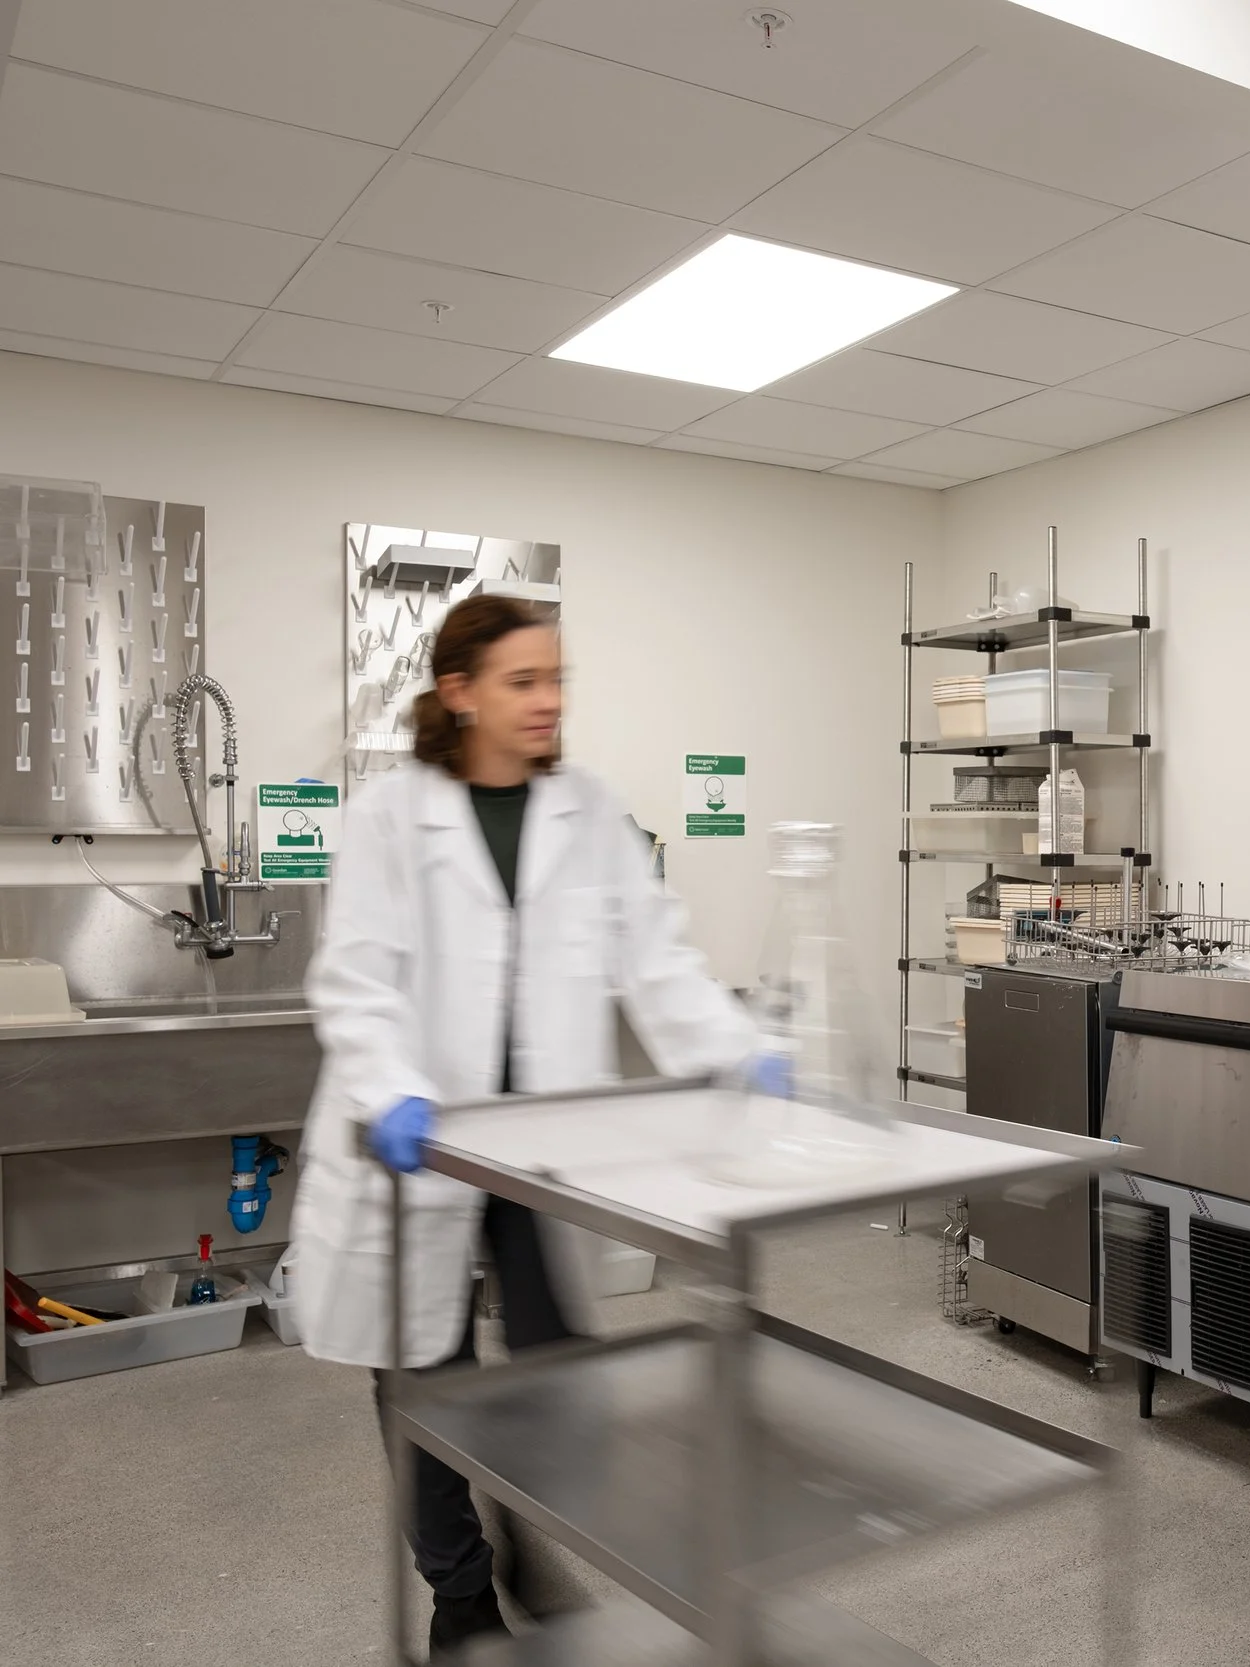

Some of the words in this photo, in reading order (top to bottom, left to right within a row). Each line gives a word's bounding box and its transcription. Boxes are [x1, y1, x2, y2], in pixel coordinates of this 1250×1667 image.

[688, 758, 719, 766] Emergency
[263, 789, 298, 797] Emergency
[263, 796, 317, 804] Eyewash/Drench
